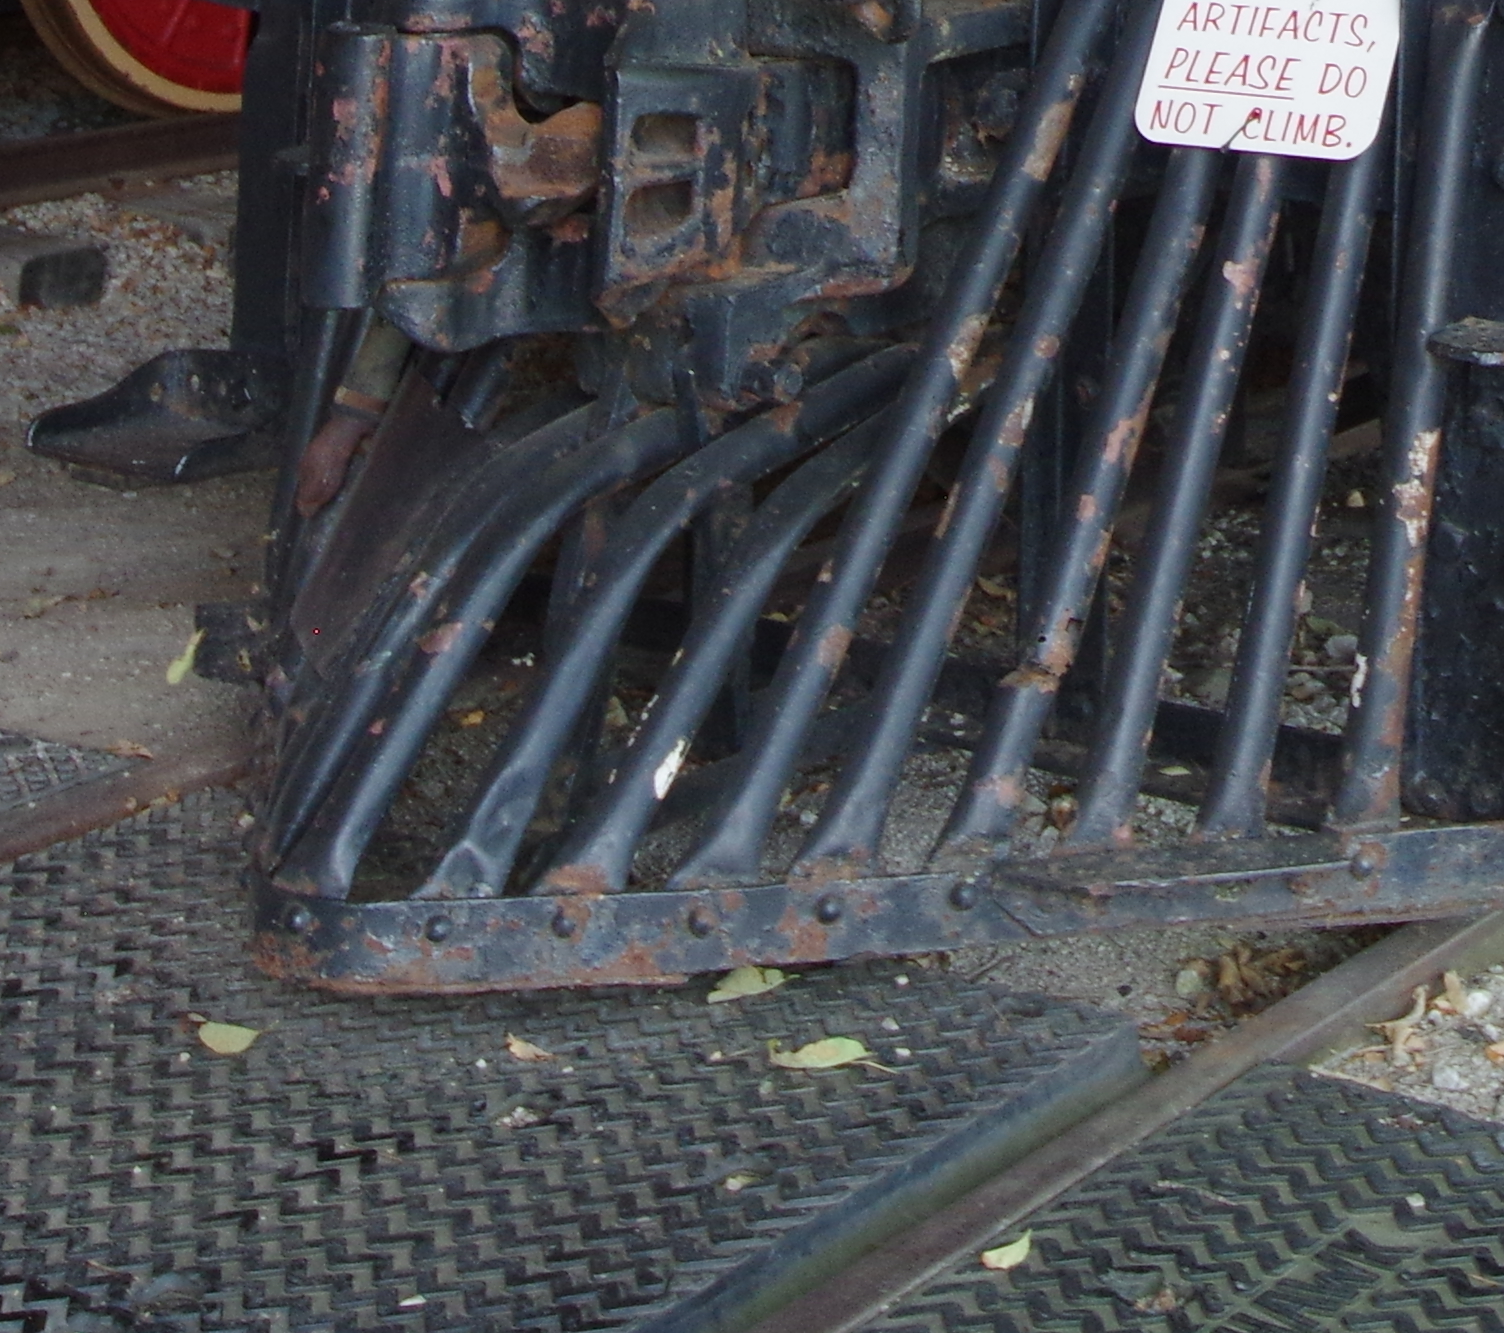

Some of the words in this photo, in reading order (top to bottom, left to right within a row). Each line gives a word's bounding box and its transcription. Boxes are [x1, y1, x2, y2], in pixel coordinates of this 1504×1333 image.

[1177, 2, 1376, 52] ARTIFACTS,
[1164, 48, 1301, 91] PLEASE
[1319, 63, 1367, 98] DO
[1149, 100, 1223, 135] NOT
[1241, 108, 1352, 148] CLIMB.
